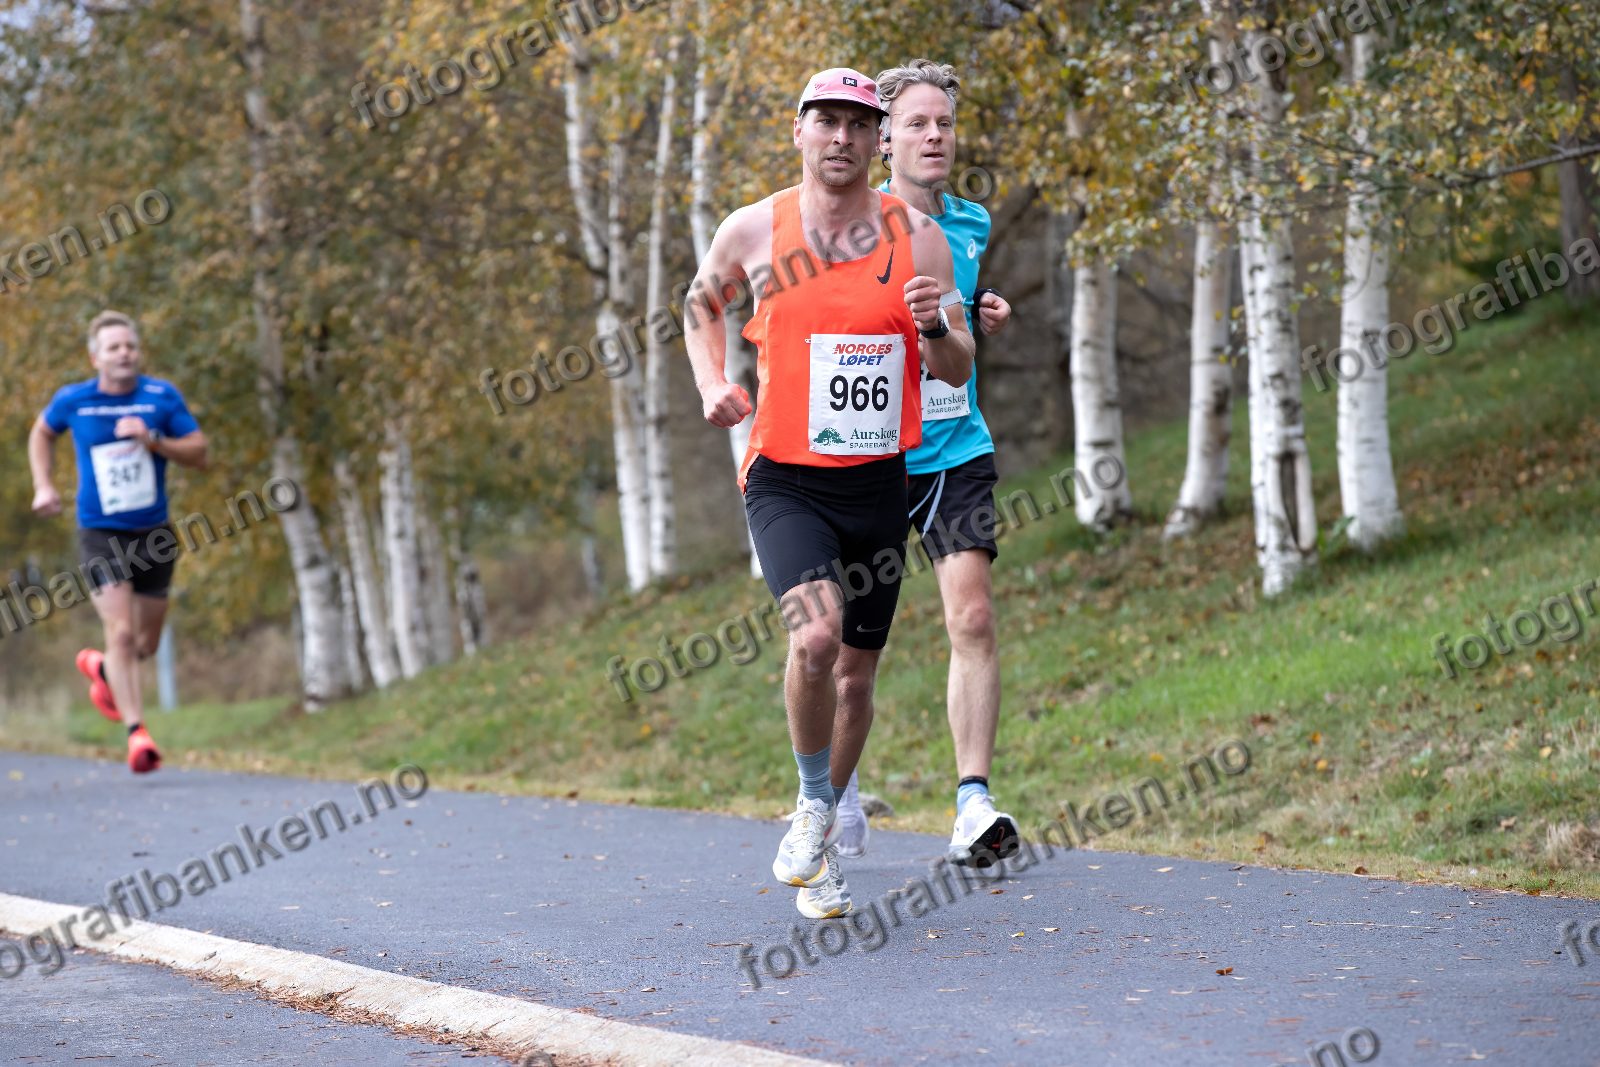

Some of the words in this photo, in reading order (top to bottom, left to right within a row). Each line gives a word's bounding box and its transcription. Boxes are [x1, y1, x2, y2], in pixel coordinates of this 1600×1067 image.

[833, 344, 893, 354] NORGES
[839, 355, 884, 366] LØPET
[829, 375, 889, 411] 966
[928, 393, 966, 405] Aurskog
[850, 428, 898, 441] Aurskog
[850, 441, 890, 449] SPAREBANK
[108, 462, 142, 487] 247
